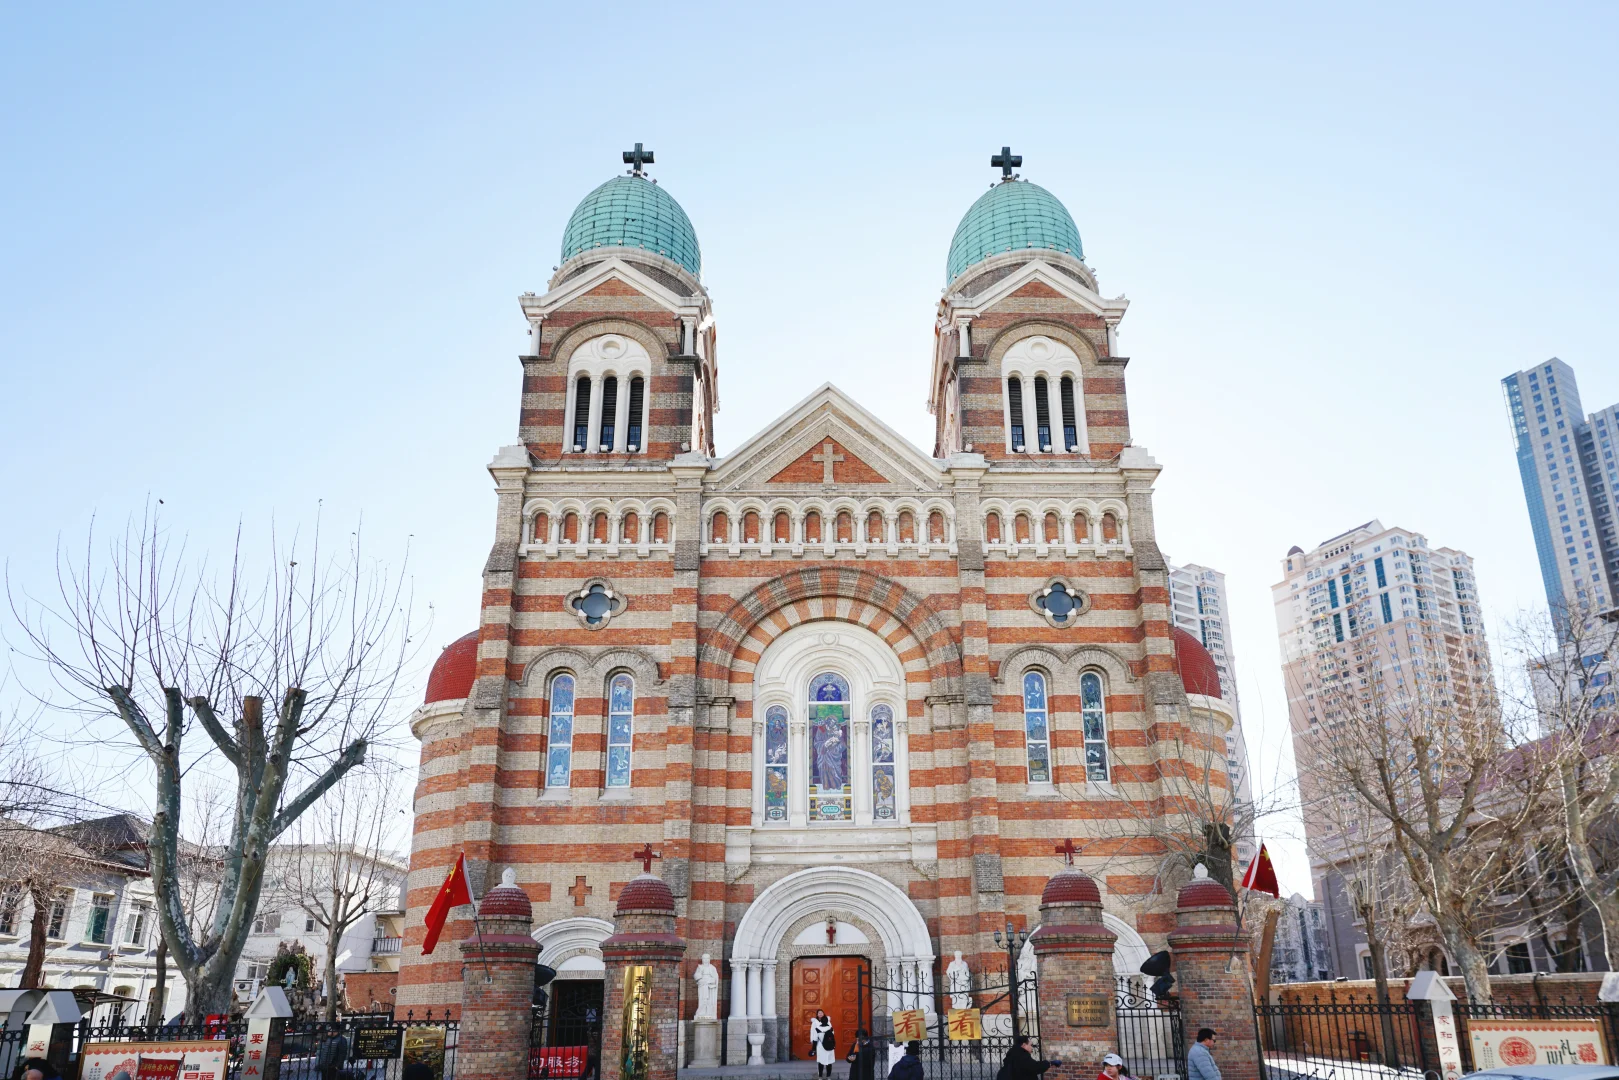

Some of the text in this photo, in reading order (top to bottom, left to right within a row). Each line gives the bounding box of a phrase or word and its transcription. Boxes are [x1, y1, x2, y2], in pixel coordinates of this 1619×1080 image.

[895, 1010, 925, 1039] 看
[950, 1010, 979, 1038] 看
[245, 1033, 264, 1076] 要信从
[1438, 1015, 1457, 1080] 家和万事
